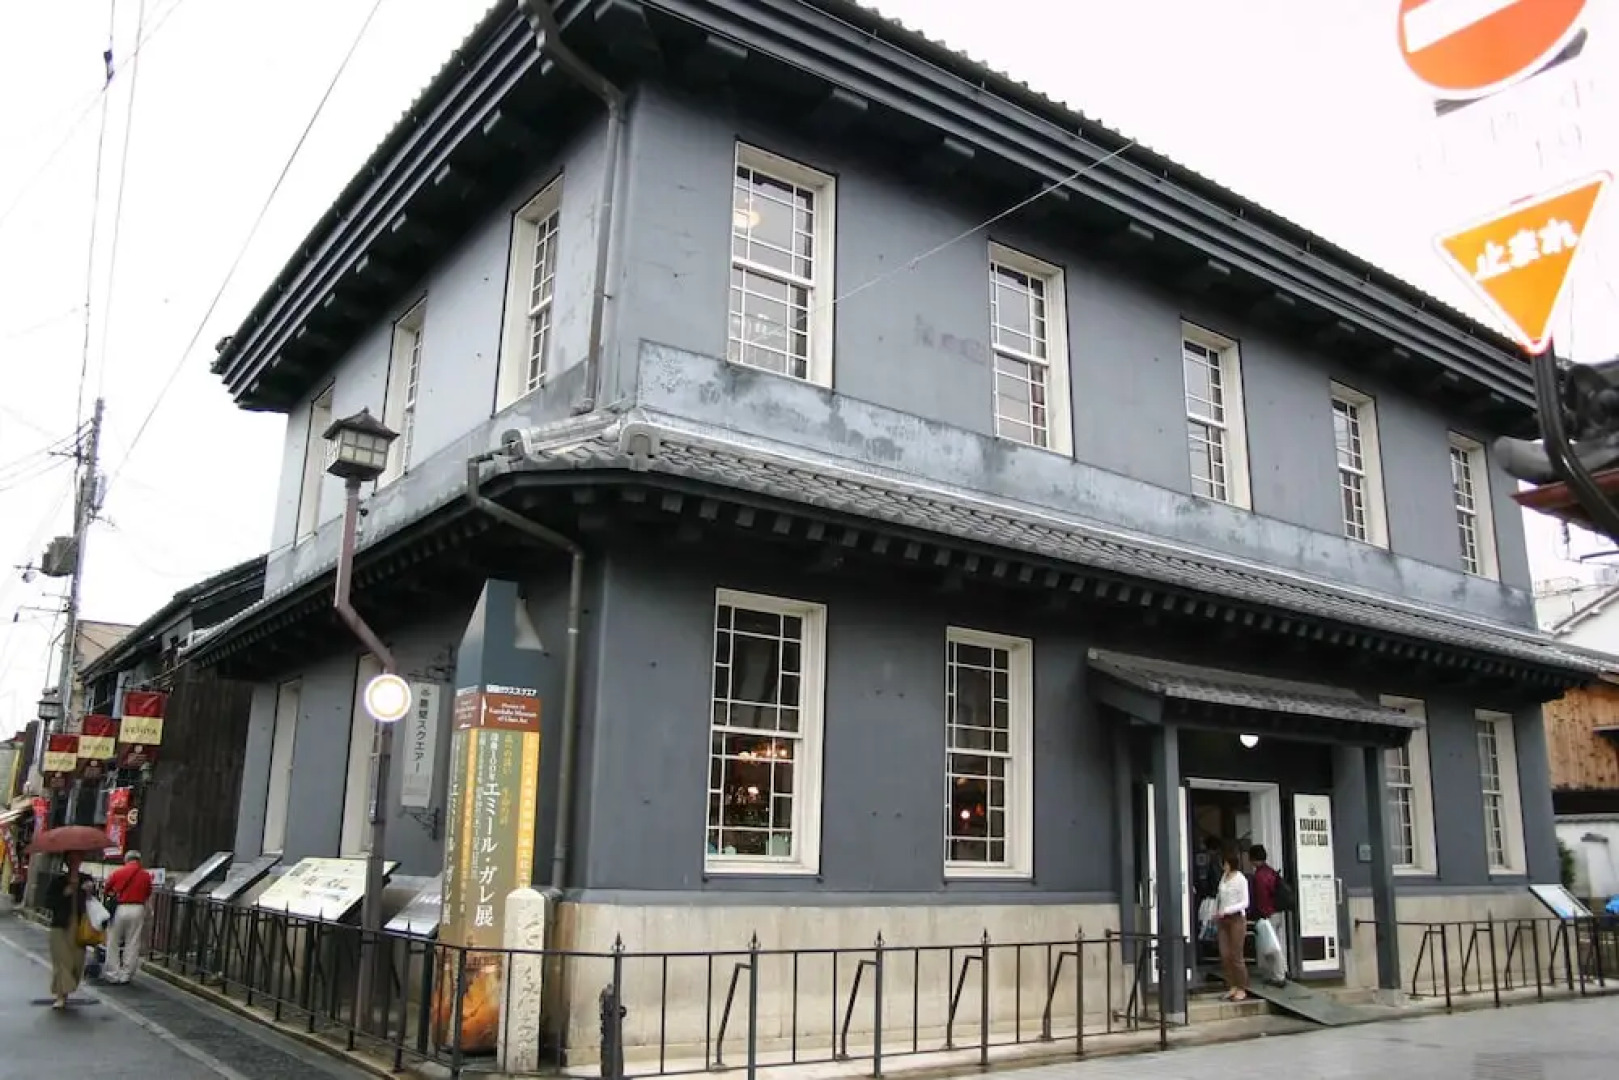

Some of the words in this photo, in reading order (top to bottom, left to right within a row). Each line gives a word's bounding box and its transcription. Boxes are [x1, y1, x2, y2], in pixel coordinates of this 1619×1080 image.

[1474, 216, 1579, 281] 止まれ
[475, 782, 502, 927] エミール・ガレ展
